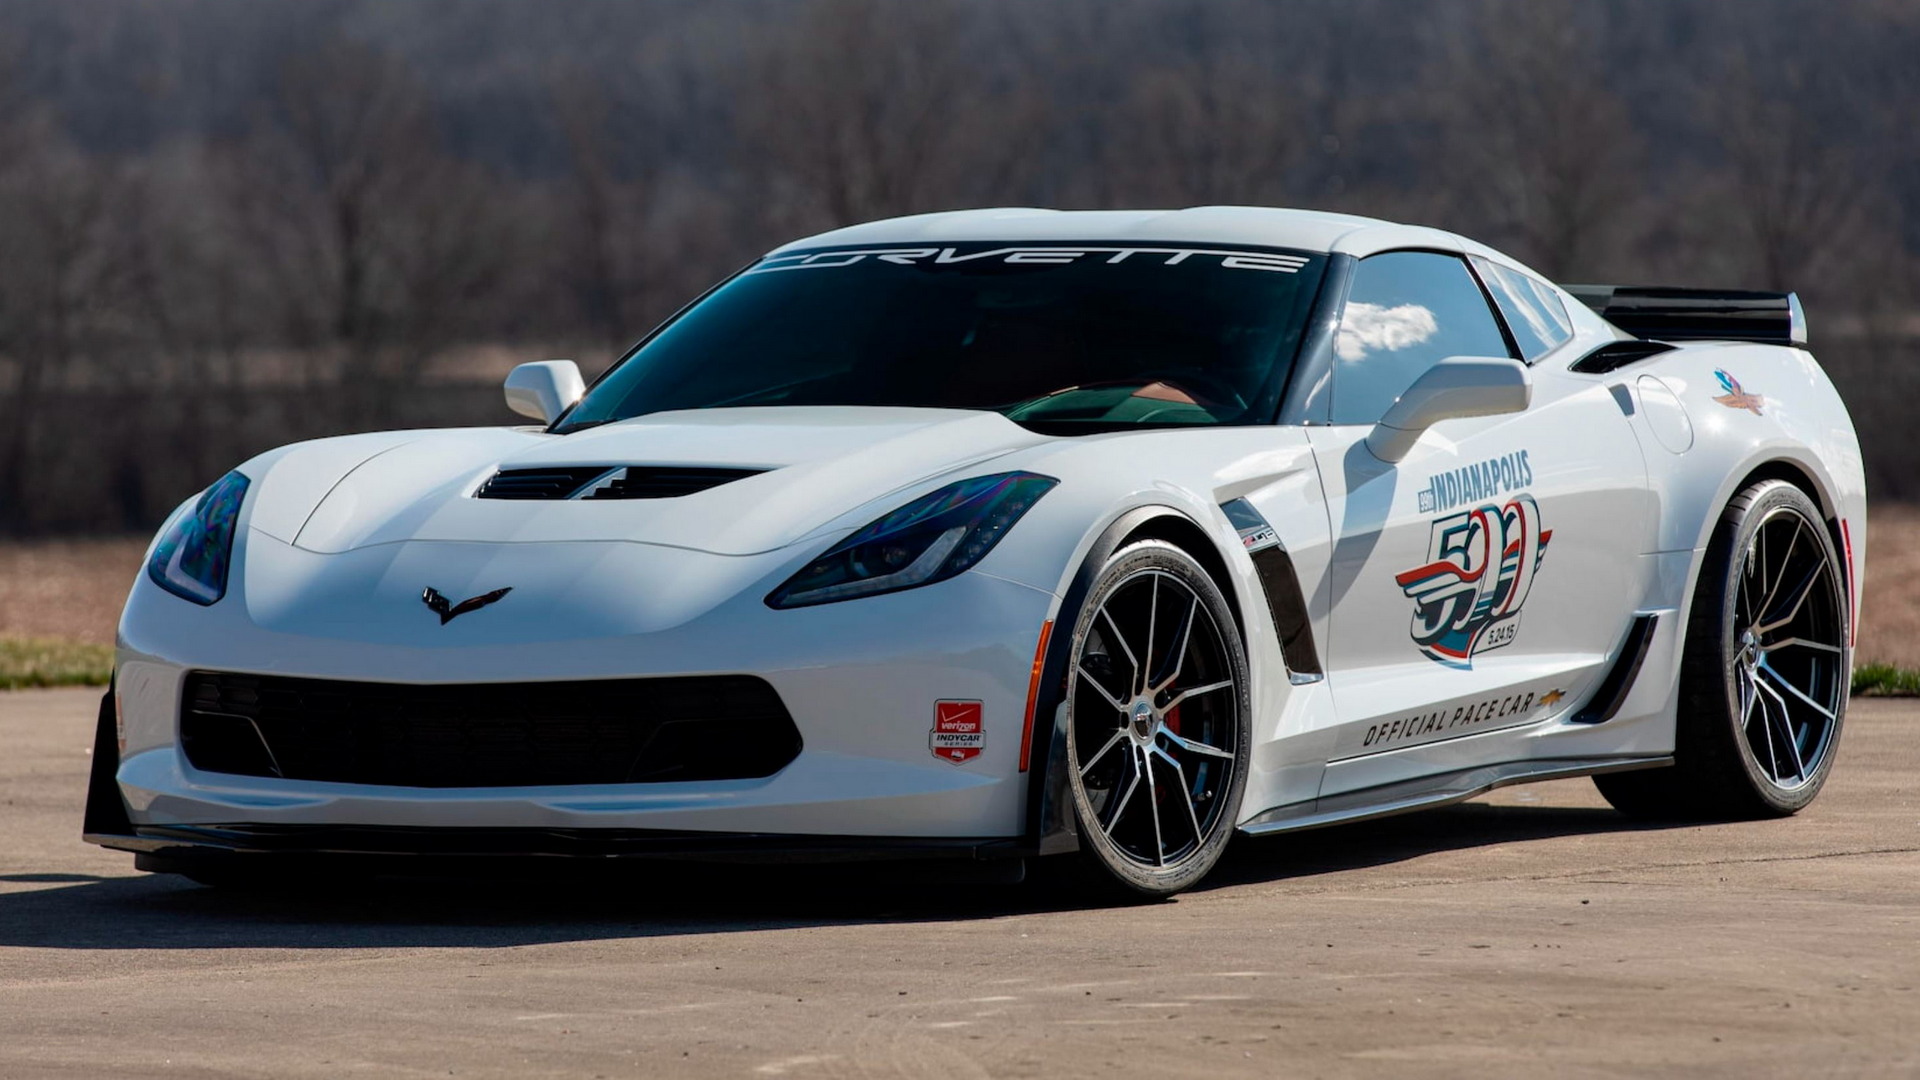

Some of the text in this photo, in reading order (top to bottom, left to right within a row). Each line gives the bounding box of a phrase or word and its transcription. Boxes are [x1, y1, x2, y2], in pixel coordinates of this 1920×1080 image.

[743, 247, 1309, 274] CORVETTE
[1430, 449, 1532, 513] INDIANAPOLIS
[1411, 493, 1541, 645] 500
[1488, 624, 1515, 645] 5.24.15
[942, 721, 976, 731] verizon
[1363, 711, 1446, 746] OFFICIAL
